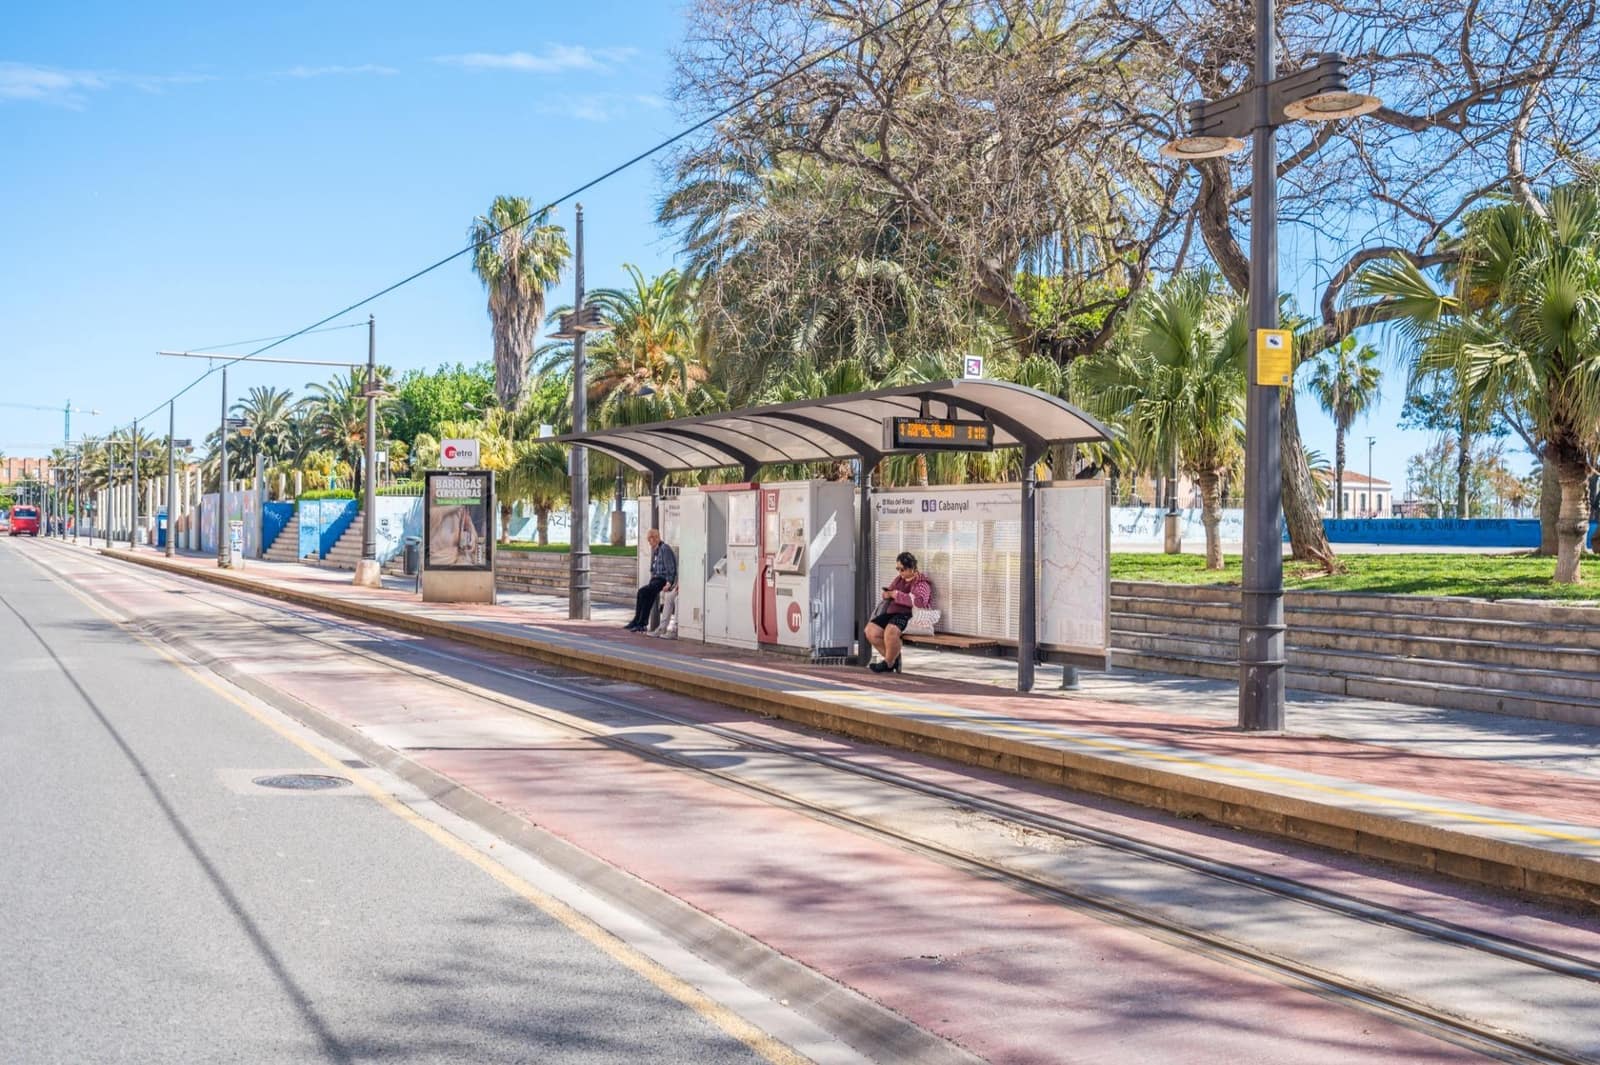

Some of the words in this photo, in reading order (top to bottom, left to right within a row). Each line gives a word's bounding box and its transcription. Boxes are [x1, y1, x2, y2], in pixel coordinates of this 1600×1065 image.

[447, 448, 473, 458] metro
[436, 479, 482, 489] BARRIGAS
[436, 489, 482, 498] CERVECERAS
[938, 499, 969, 514] Cabanyal
